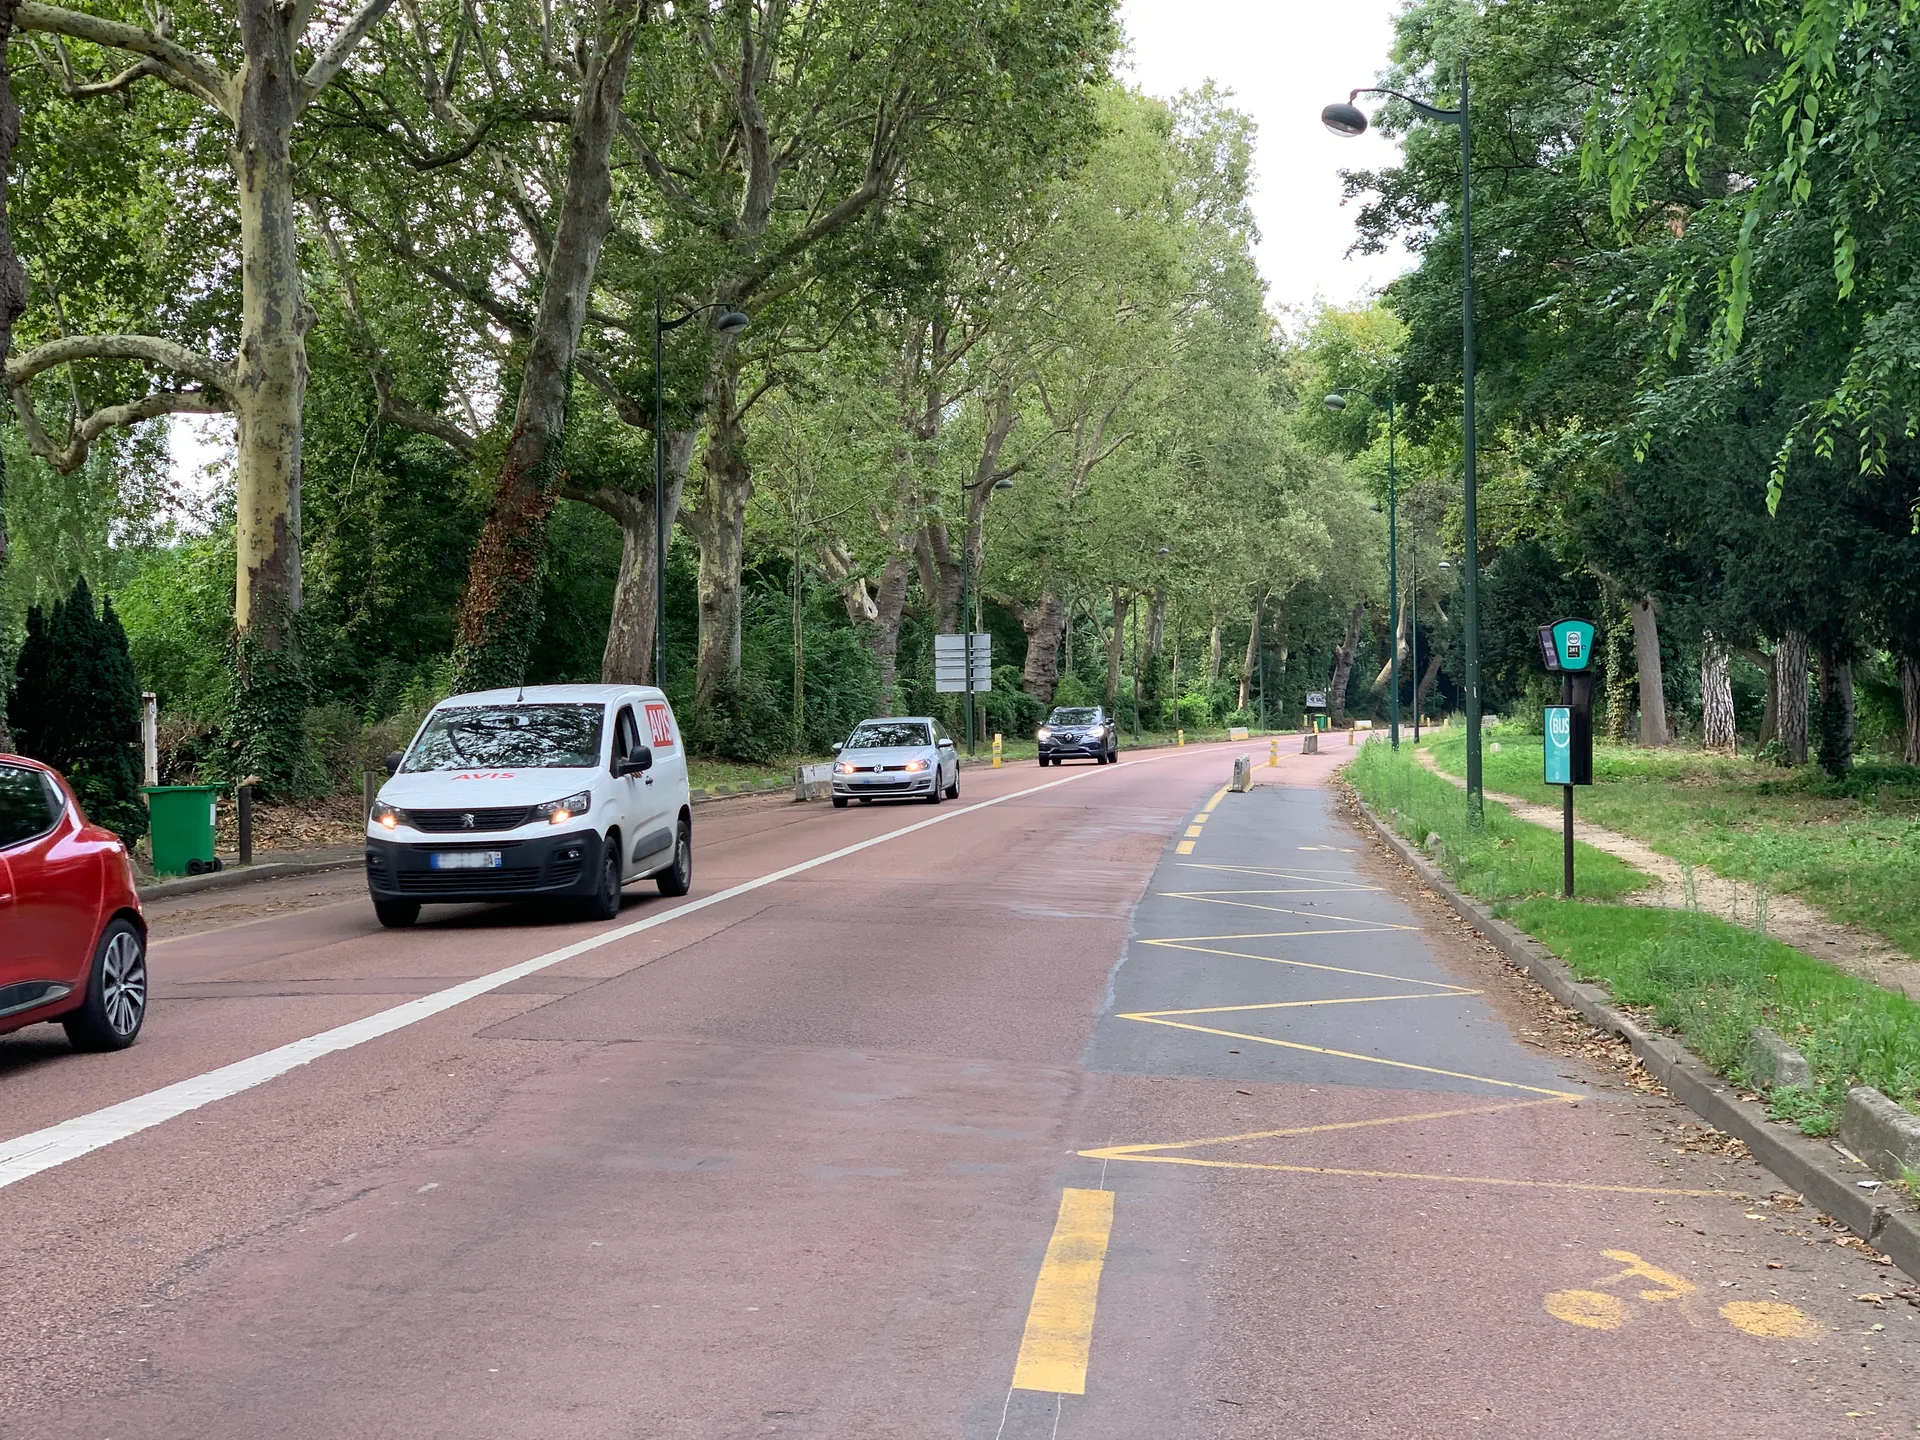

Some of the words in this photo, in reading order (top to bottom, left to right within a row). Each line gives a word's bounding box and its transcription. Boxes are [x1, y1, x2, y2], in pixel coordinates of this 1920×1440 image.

[649, 709, 672, 742] AVIS
[1552, 717, 1570, 734] BUS
[450, 772, 516, 780] AVIS
